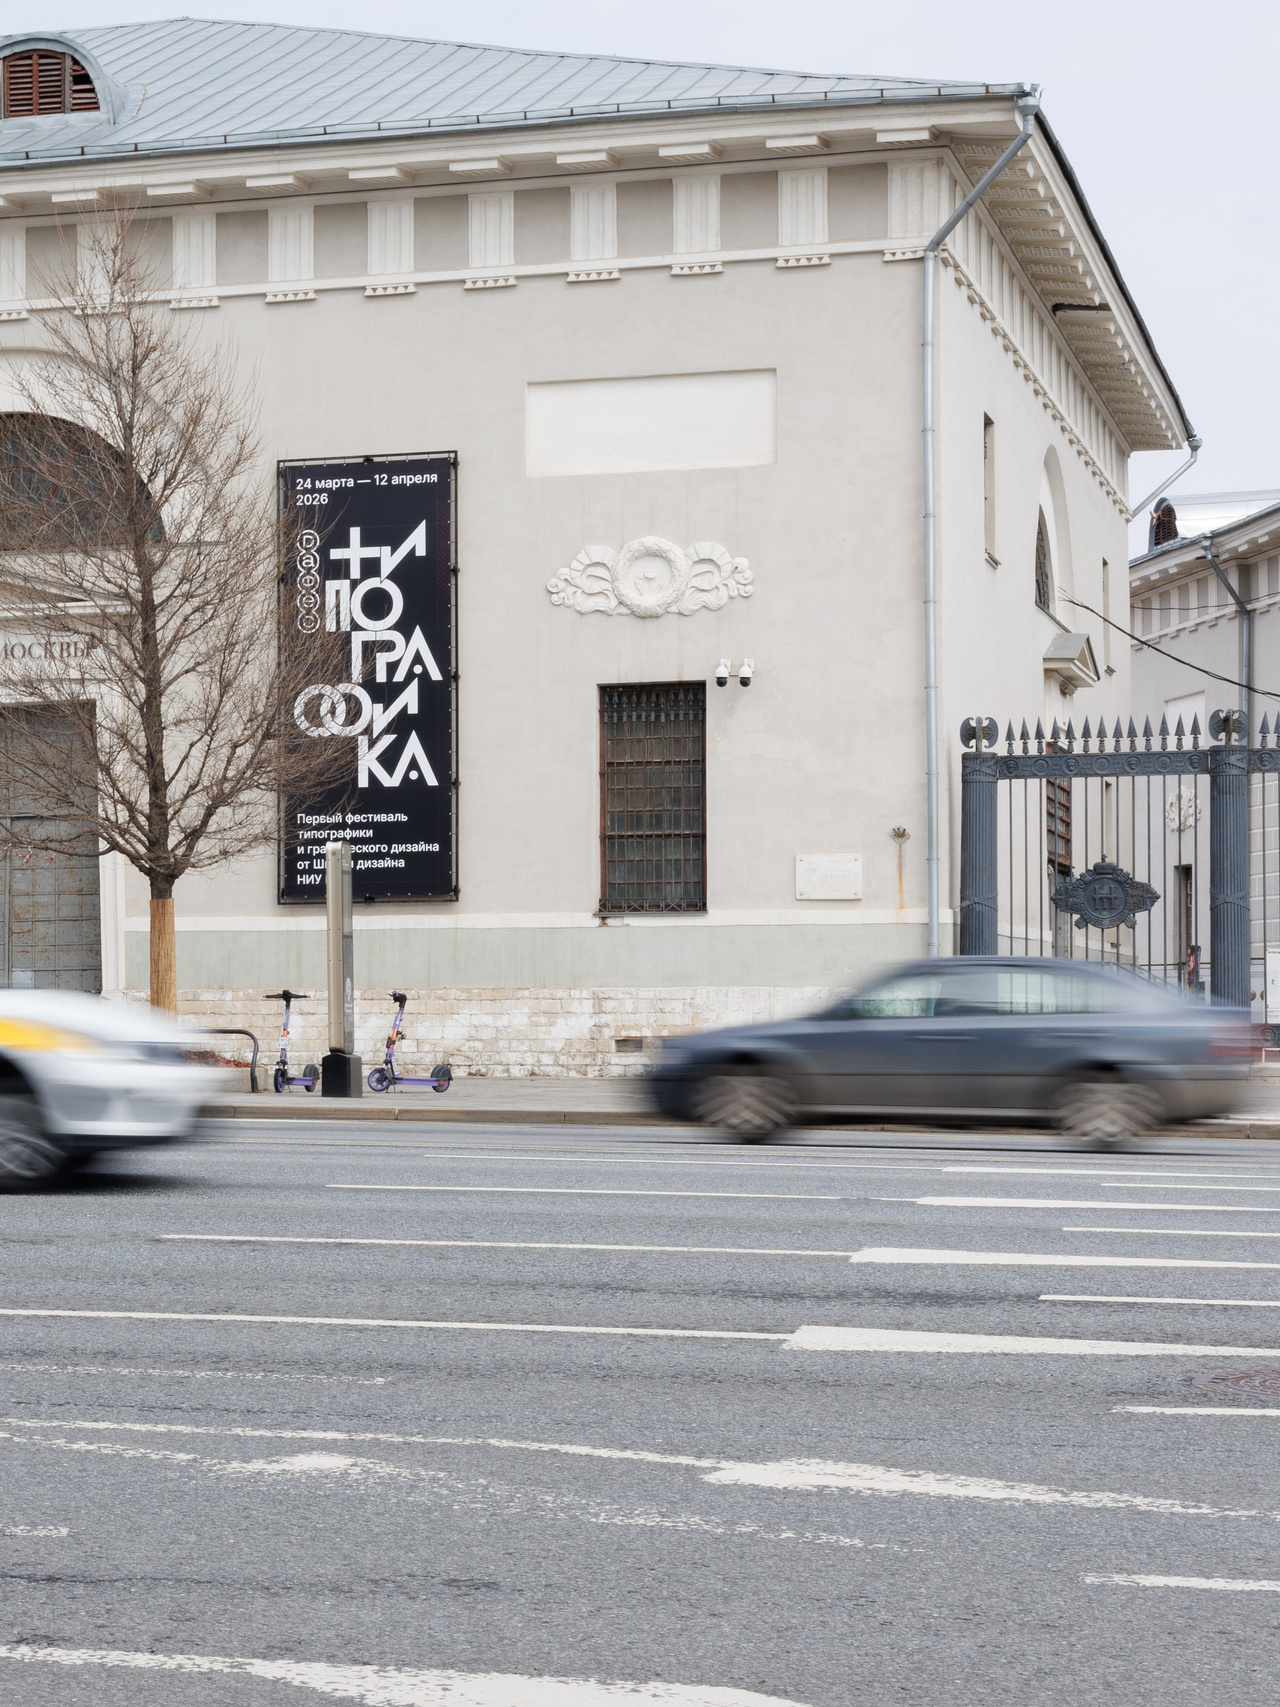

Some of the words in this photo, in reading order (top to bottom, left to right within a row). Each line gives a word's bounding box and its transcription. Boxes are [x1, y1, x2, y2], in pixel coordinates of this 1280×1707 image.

[296, 478, 312, 490] 24
[315, 477, 354, 490] марта
[374, 474, 388, 486] 12
[391, 472, 438, 487] апреля
[296, 493, 329, 506] 2026
[358, 730, 439, 788] КА
[297, 813, 342, 826] Первый
[345, 811, 408, 825] фестиваль
[297, 828, 373, 841] типографики
[297, 845, 305, 854] и
[307, 843, 388, 857] граеского
[391, 840, 439, 855] дизайна
[297, 860, 310, 870] от
[356, 857, 405, 871] дизайна
[297, 873, 322, 885] НИУ
